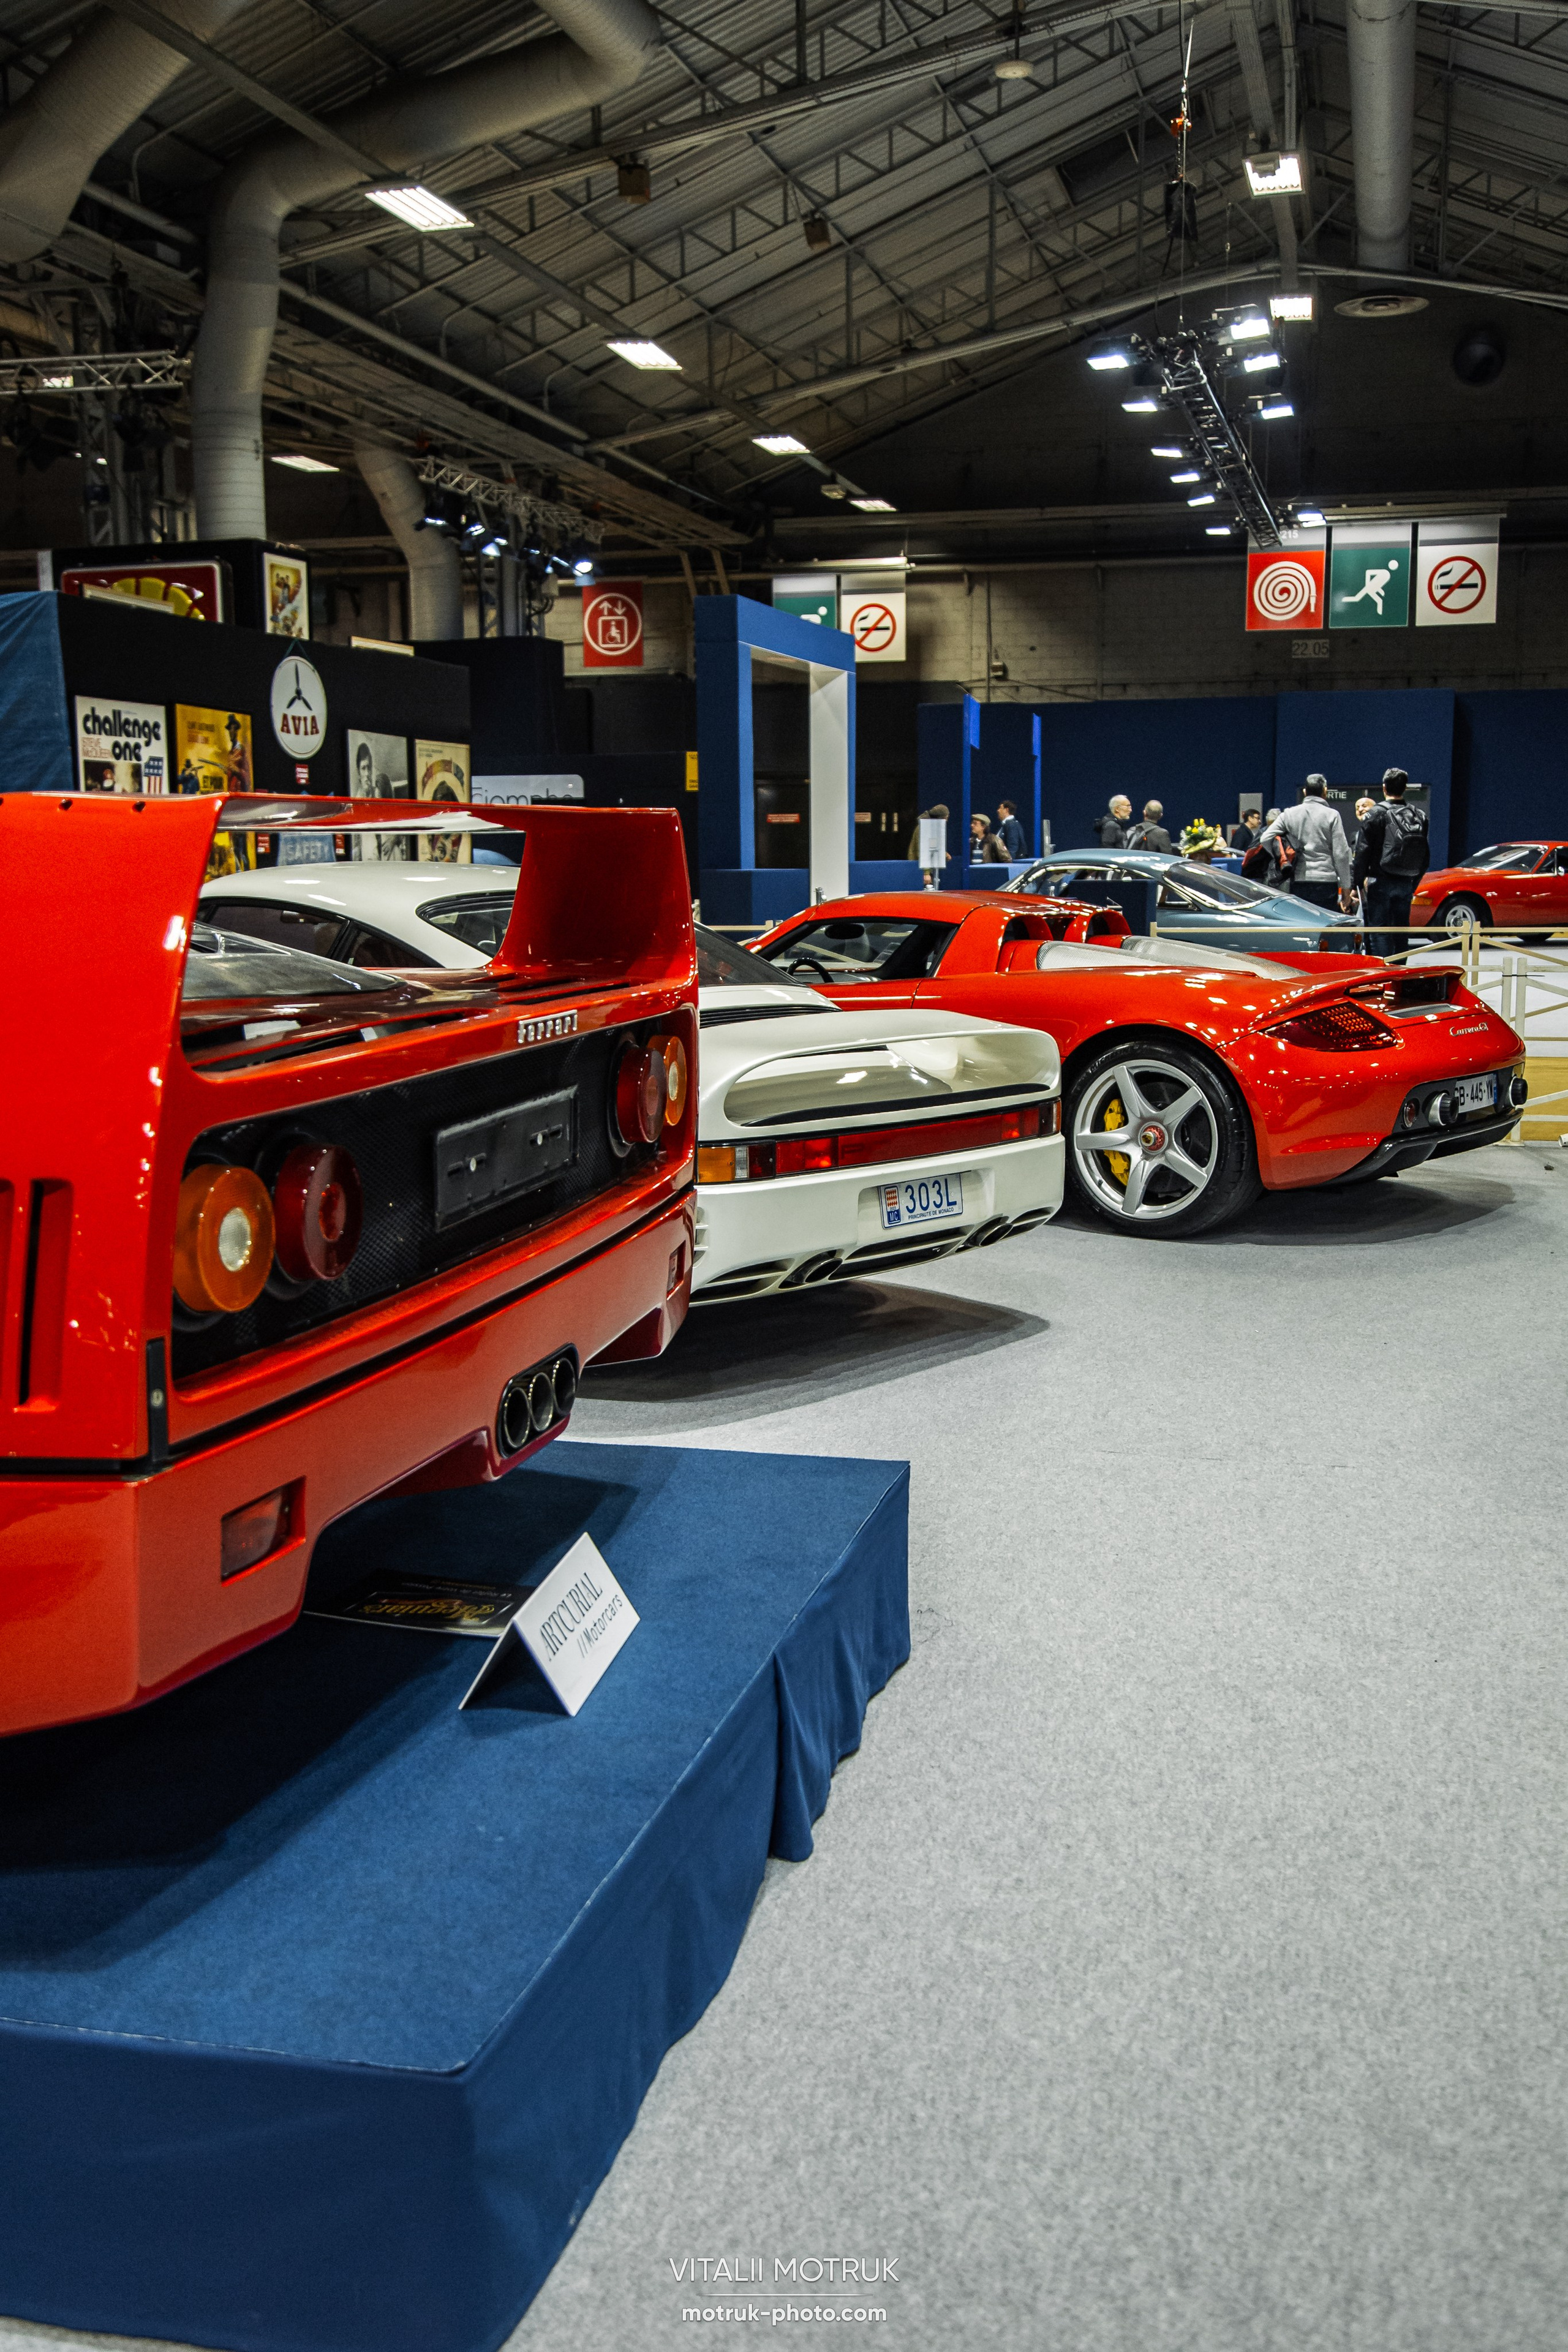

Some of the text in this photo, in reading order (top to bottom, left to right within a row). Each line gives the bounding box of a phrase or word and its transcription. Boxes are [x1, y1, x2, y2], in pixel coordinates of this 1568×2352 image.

[1293, 642, 1329, 655] 22.05
[83, 706, 161, 747] challenge
[281, 713, 319, 736] AVIA
[112, 740, 141, 761] one
[905, 1178, 957, 1213] 303L
[889, 1211, 898, 1221] MC
[908, 1211, 932, 1219] PRINCIPAUTE
[540, 1572, 603, 1662] ARTCURIAL
